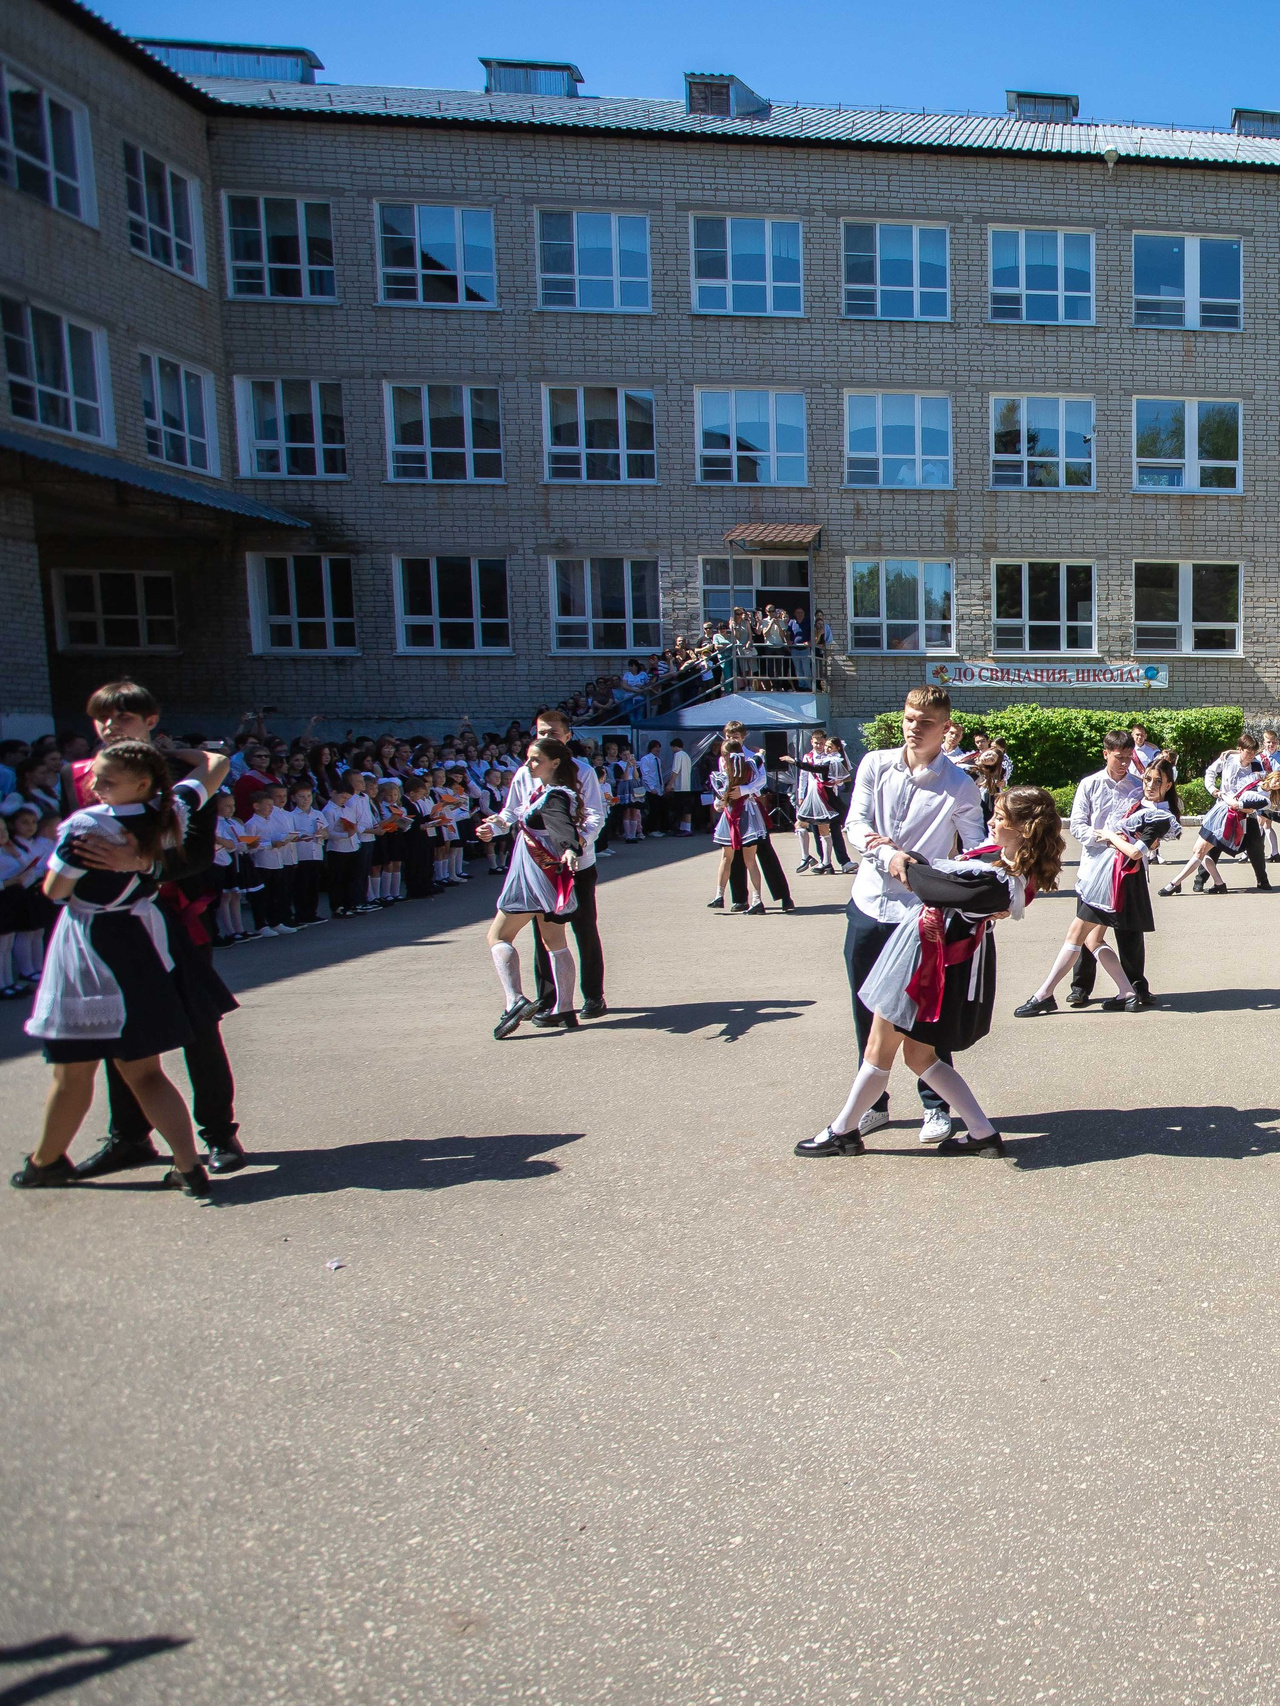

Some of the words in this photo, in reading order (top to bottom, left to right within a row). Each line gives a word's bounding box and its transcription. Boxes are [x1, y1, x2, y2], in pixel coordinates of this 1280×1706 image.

[952, 667, 975, 683] ДО
[978, 667, 1072, 685] СВИДАНИЯ,
[1076, 668, 1140, 683] ШКОЛА!
